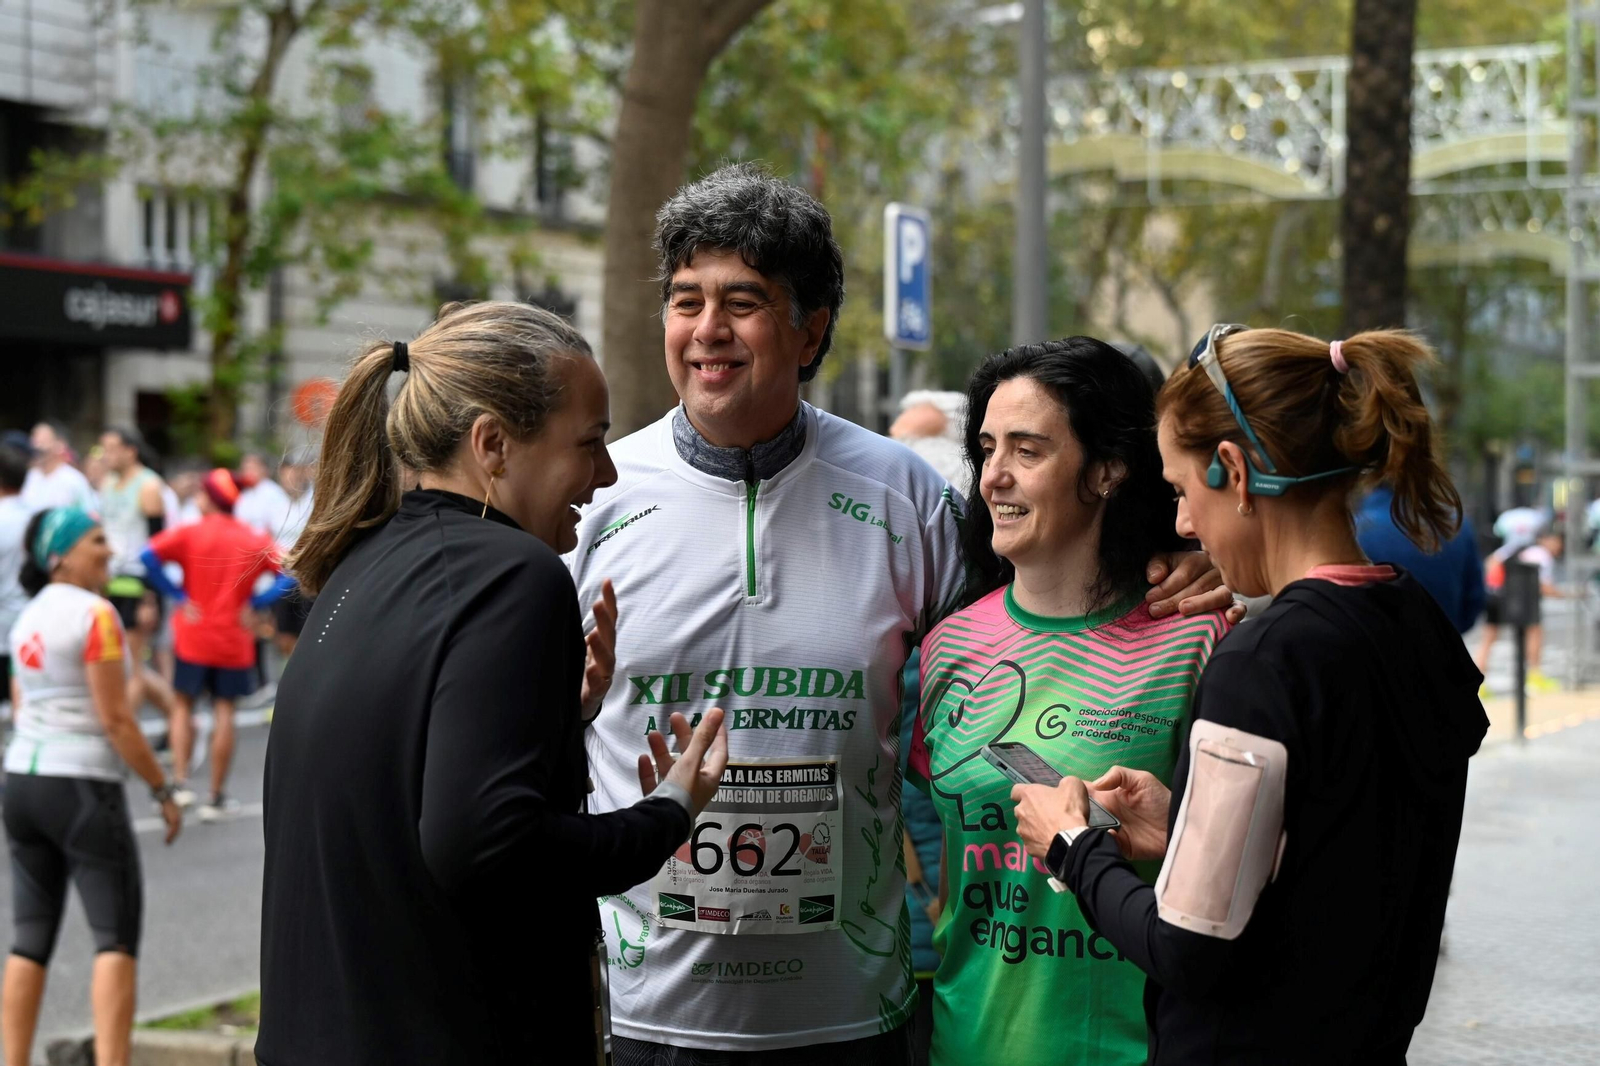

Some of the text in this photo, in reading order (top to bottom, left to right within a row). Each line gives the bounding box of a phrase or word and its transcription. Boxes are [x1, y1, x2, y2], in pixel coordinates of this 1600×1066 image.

[901, 219, 925, 284] P
[828, 492, 903, 544] SIG Labral
[628, 667, 867, 706] XII SUBIDA
[644, 715, 657, 735] A
[730, 706, 857, 732] ERMITAS
[1075, 718, 1159, 736] contra el cáncer
[1079, 708, 1132, 718] asociación
[1085, 728, 1131, 743] Córdoba
[735, 769, 745, 783] A
[748, 770, 773, 784] LAS
[776, 768, 829, 783] ERMITAS
[766, 790, 781, 804] DE
[783, 788, 833, 803] ORGANOS
[957, 794, 1008, 831] La
[690, 822, 802, 877] 662
[705, 909, 730, 917] IMDECO
[963, 881, 1029, 917] que
[970, 918, 1124, 965] enganc
[718, 959, 803, 976] IMDECO
